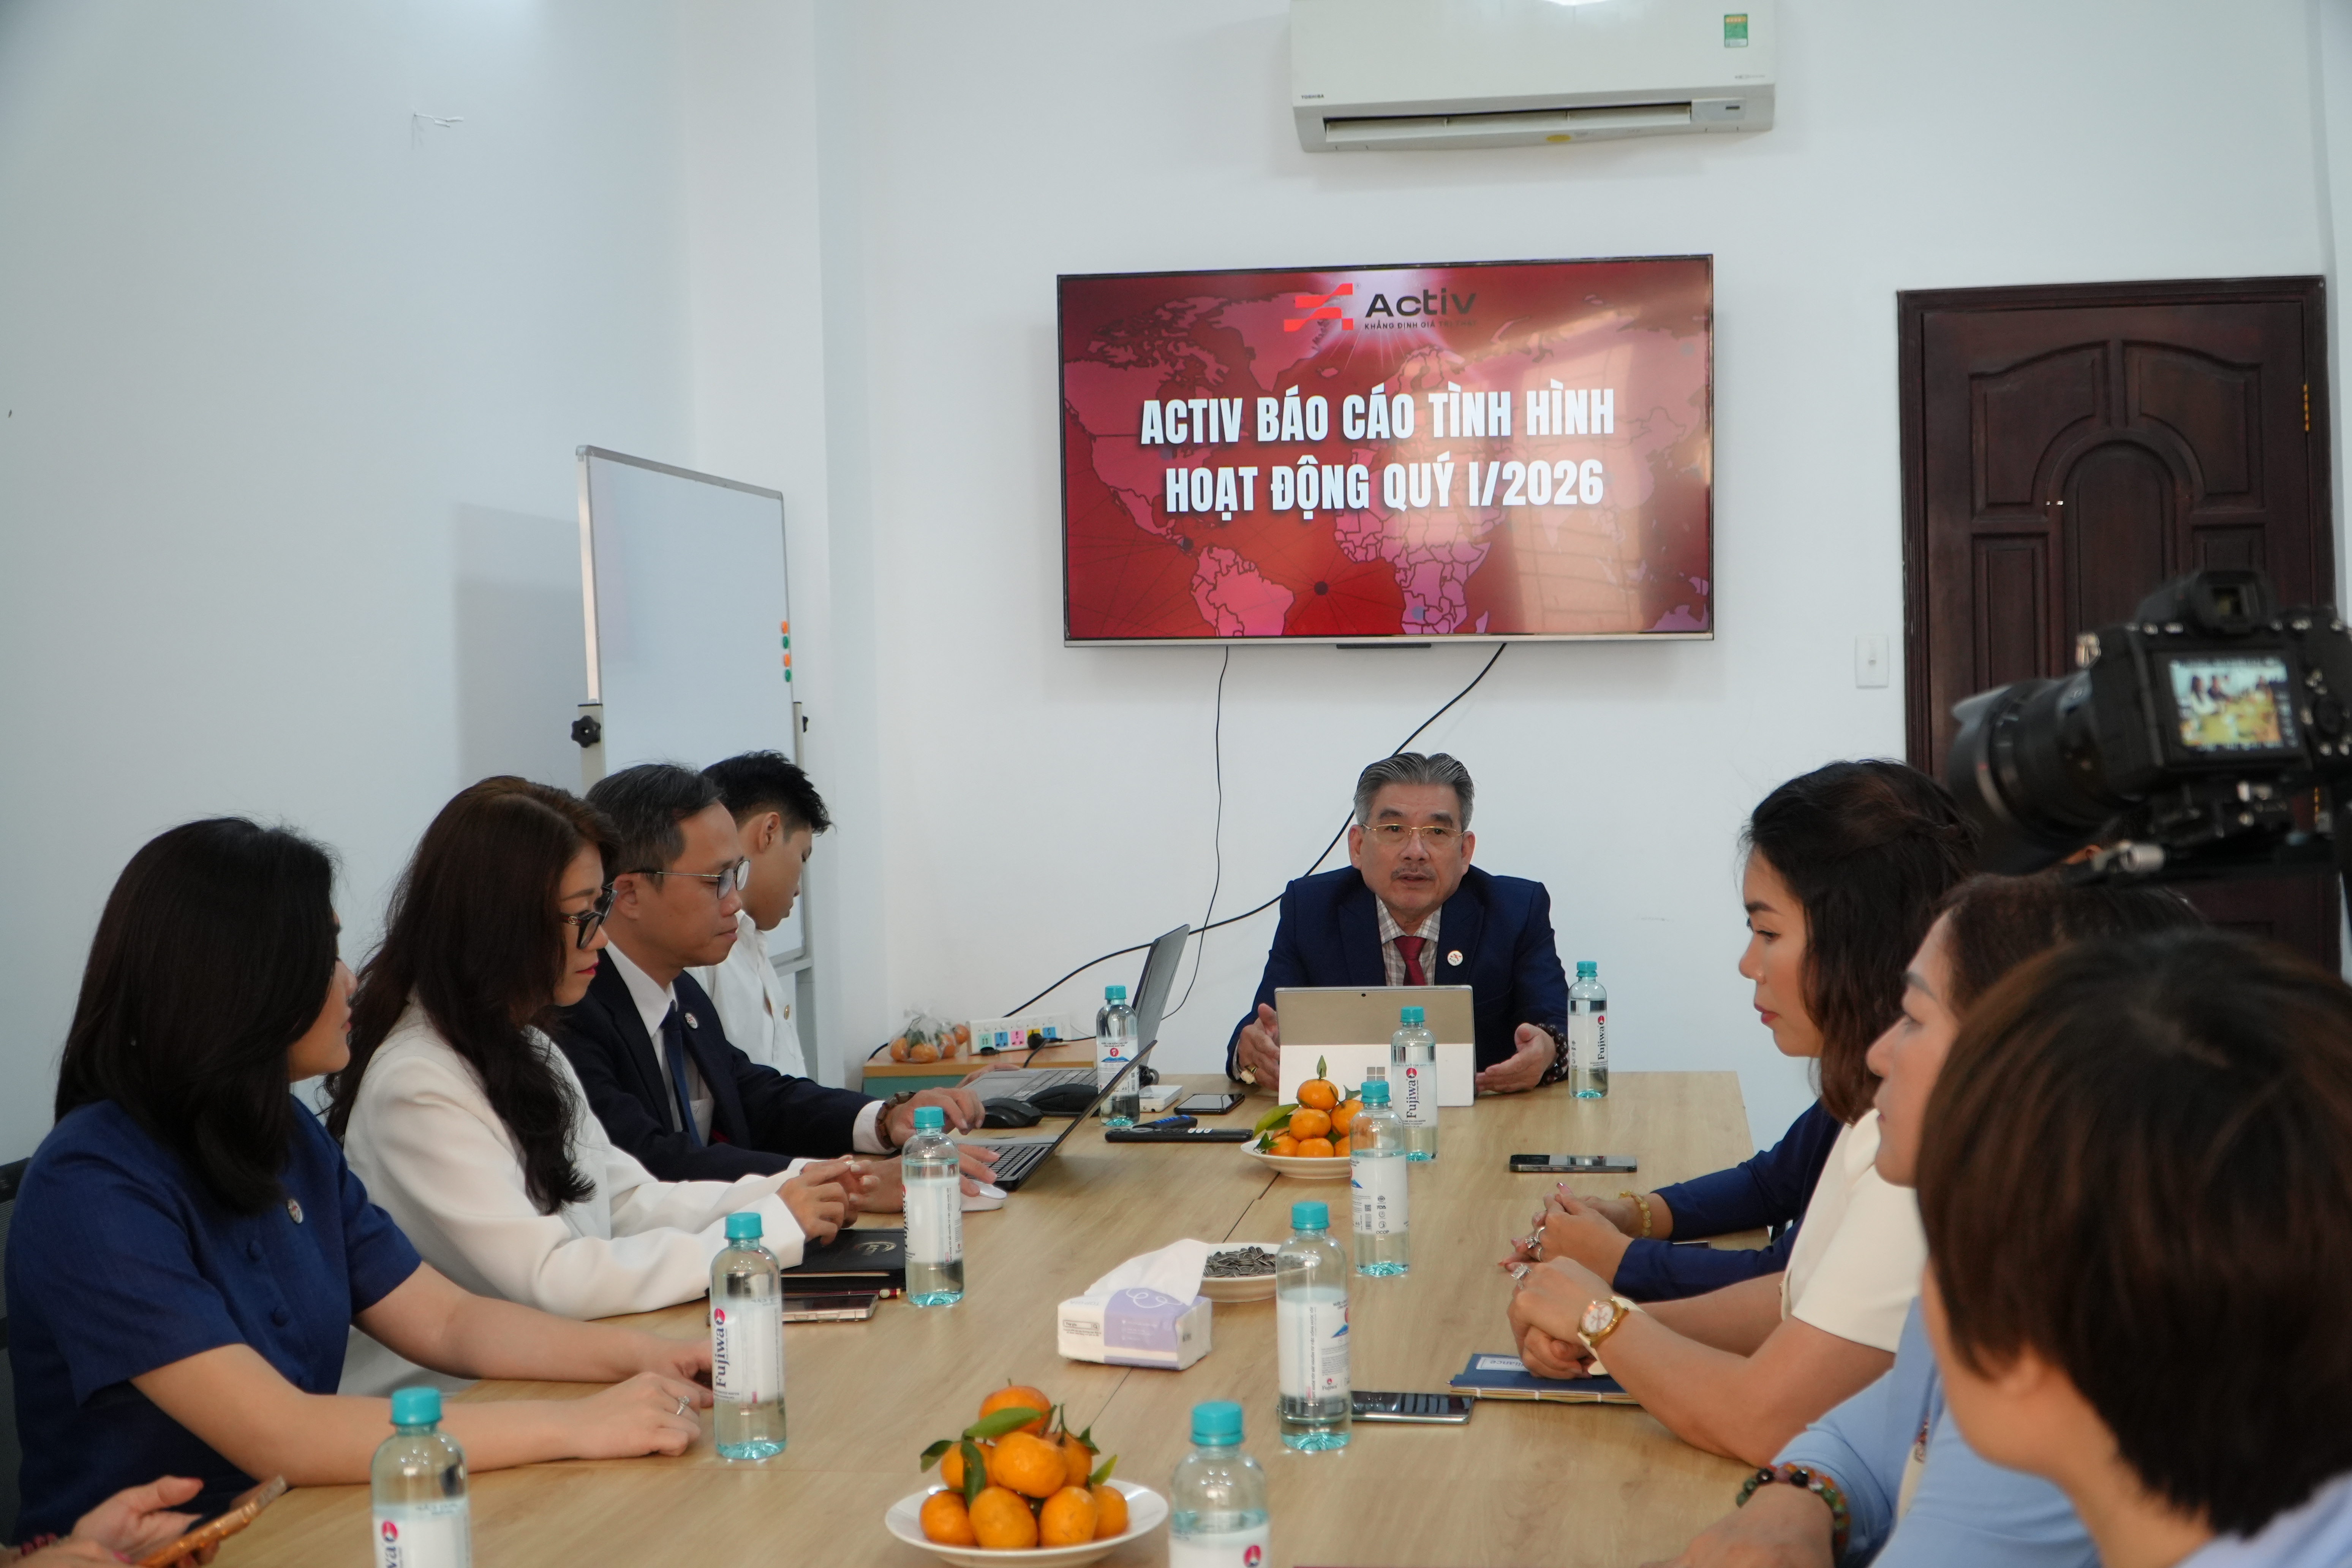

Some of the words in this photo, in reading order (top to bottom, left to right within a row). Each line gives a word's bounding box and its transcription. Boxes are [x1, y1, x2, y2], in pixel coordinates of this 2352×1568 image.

[1365, 288, 1476, 319] Activ
[1397, 322, 1418, 331] ĐỊNH
[1141, 398, 1242, 444] ACTIV
[1257, 385, 1328, 441] BÁO
[1343, 383, 1415, 439] CÁO
[1428, 381, 1511, 438] TÌNH
[1526, 378, 1614, 436] HÌNH
[1167, 467, 1258, 521] HOẠT
[1271, 455, 1369, 520] ĐỘNG
[1383, 450, 1455, 512] QUÝ
[1468, 458, 1605, 507] I/2026
[1406, 1080, 1420, 1119] Fujiwa
[715, 1328, 730, 1389] Fujiwa
